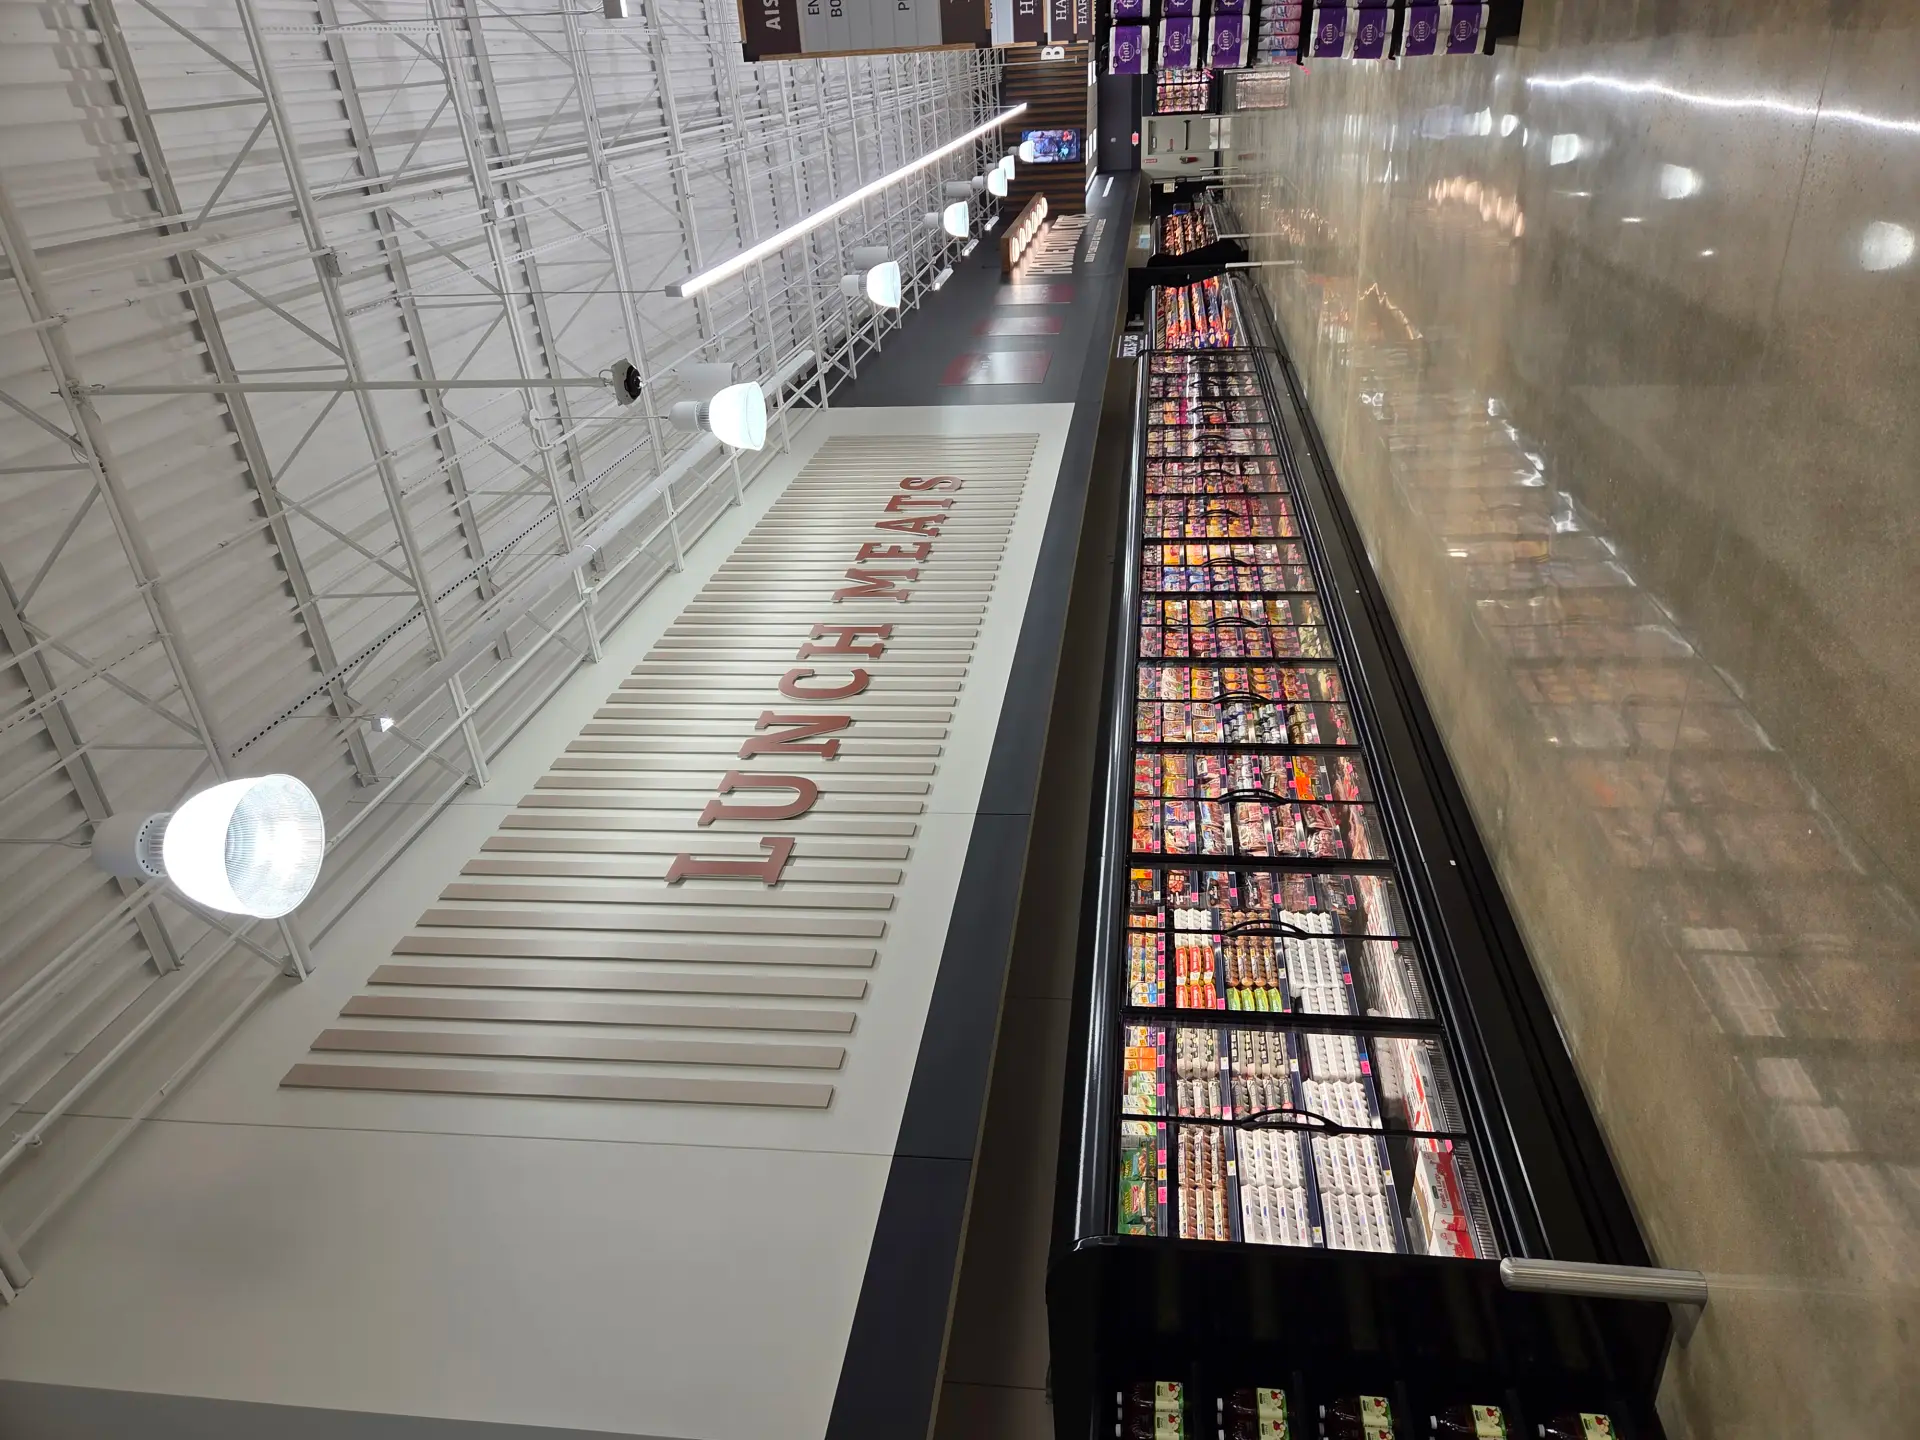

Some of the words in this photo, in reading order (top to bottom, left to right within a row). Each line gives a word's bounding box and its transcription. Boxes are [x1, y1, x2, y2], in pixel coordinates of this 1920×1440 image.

[1169, 31, 1181, 52] fiora
[1218, 29, 1230, 51] fiora
[1322, 23, 1333, 44] fiora
[1362, 24, 1373, 45] fiora
[1415, 20, 1425, 42] fiora
[1456, 20, 1467, 42] fiora
[1118, 42, 1131, 62] fiora
[663, 623, 893, 886] LUNCH
[830, 475, 962, 603] MEATS
